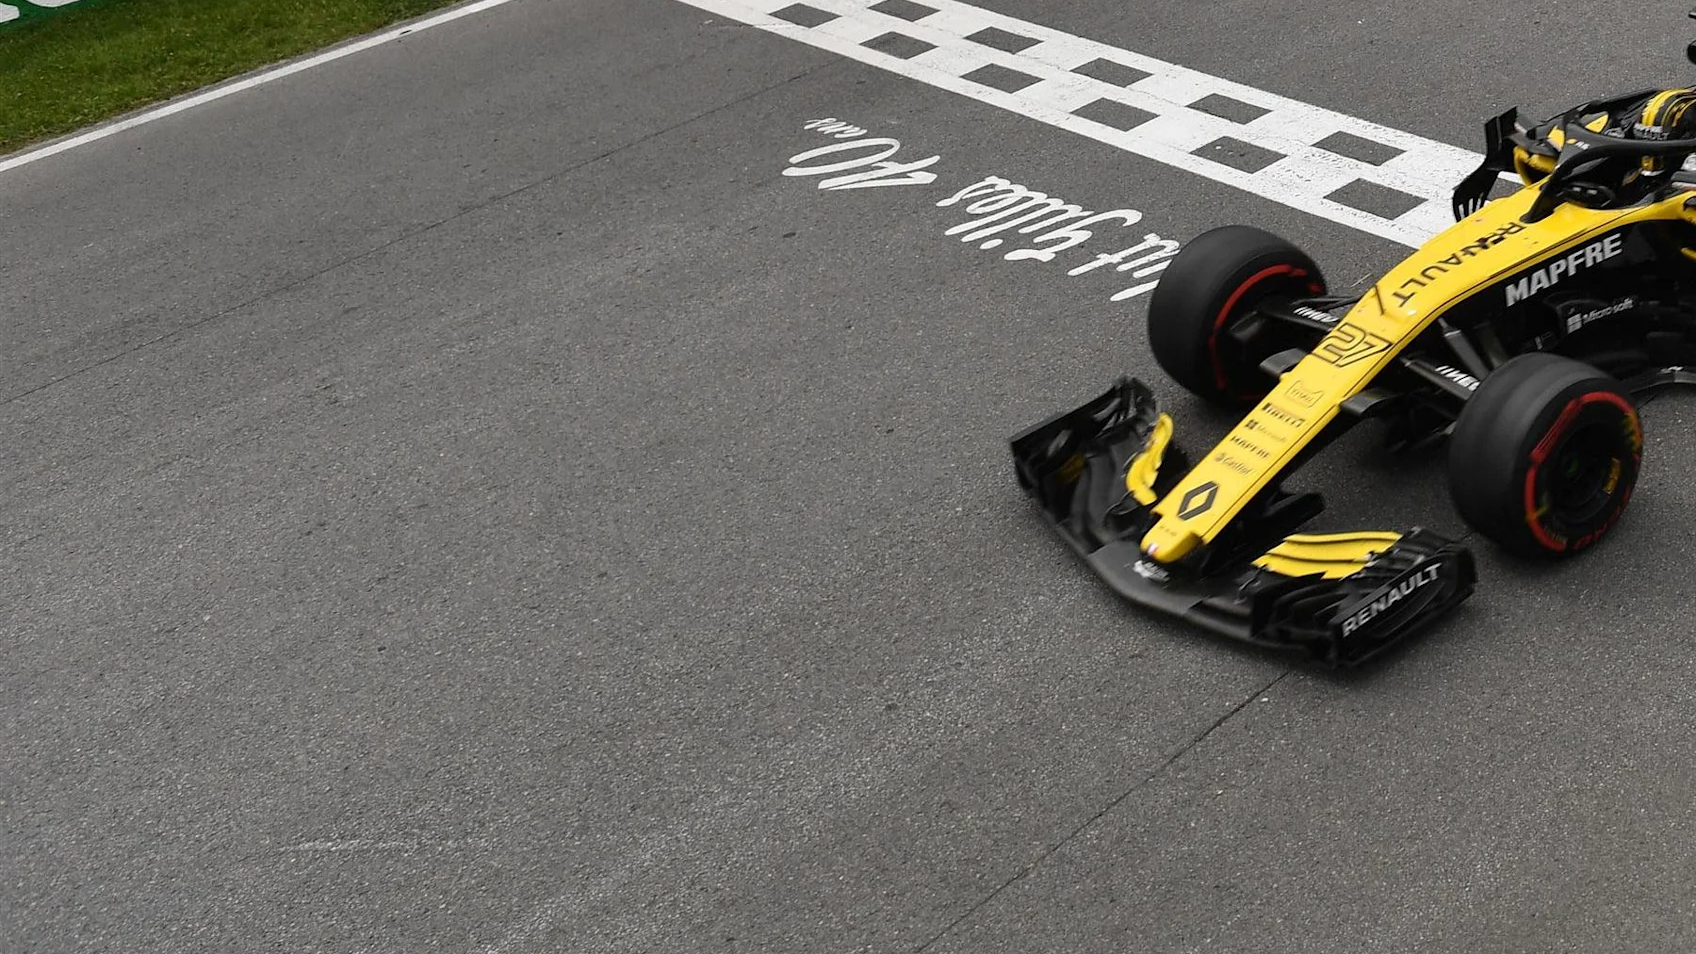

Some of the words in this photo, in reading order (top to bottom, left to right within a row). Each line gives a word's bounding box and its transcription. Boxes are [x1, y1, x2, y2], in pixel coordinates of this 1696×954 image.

[1391, 222, 1527, 307] RENAULT
[1505, 233, 1623, 307] MAPFRE
[1311, 322, 1394, 368] 27
[1583, 297, 1634, 325] Microsoft
[1342, 562, 1442, 638] RENAULT
